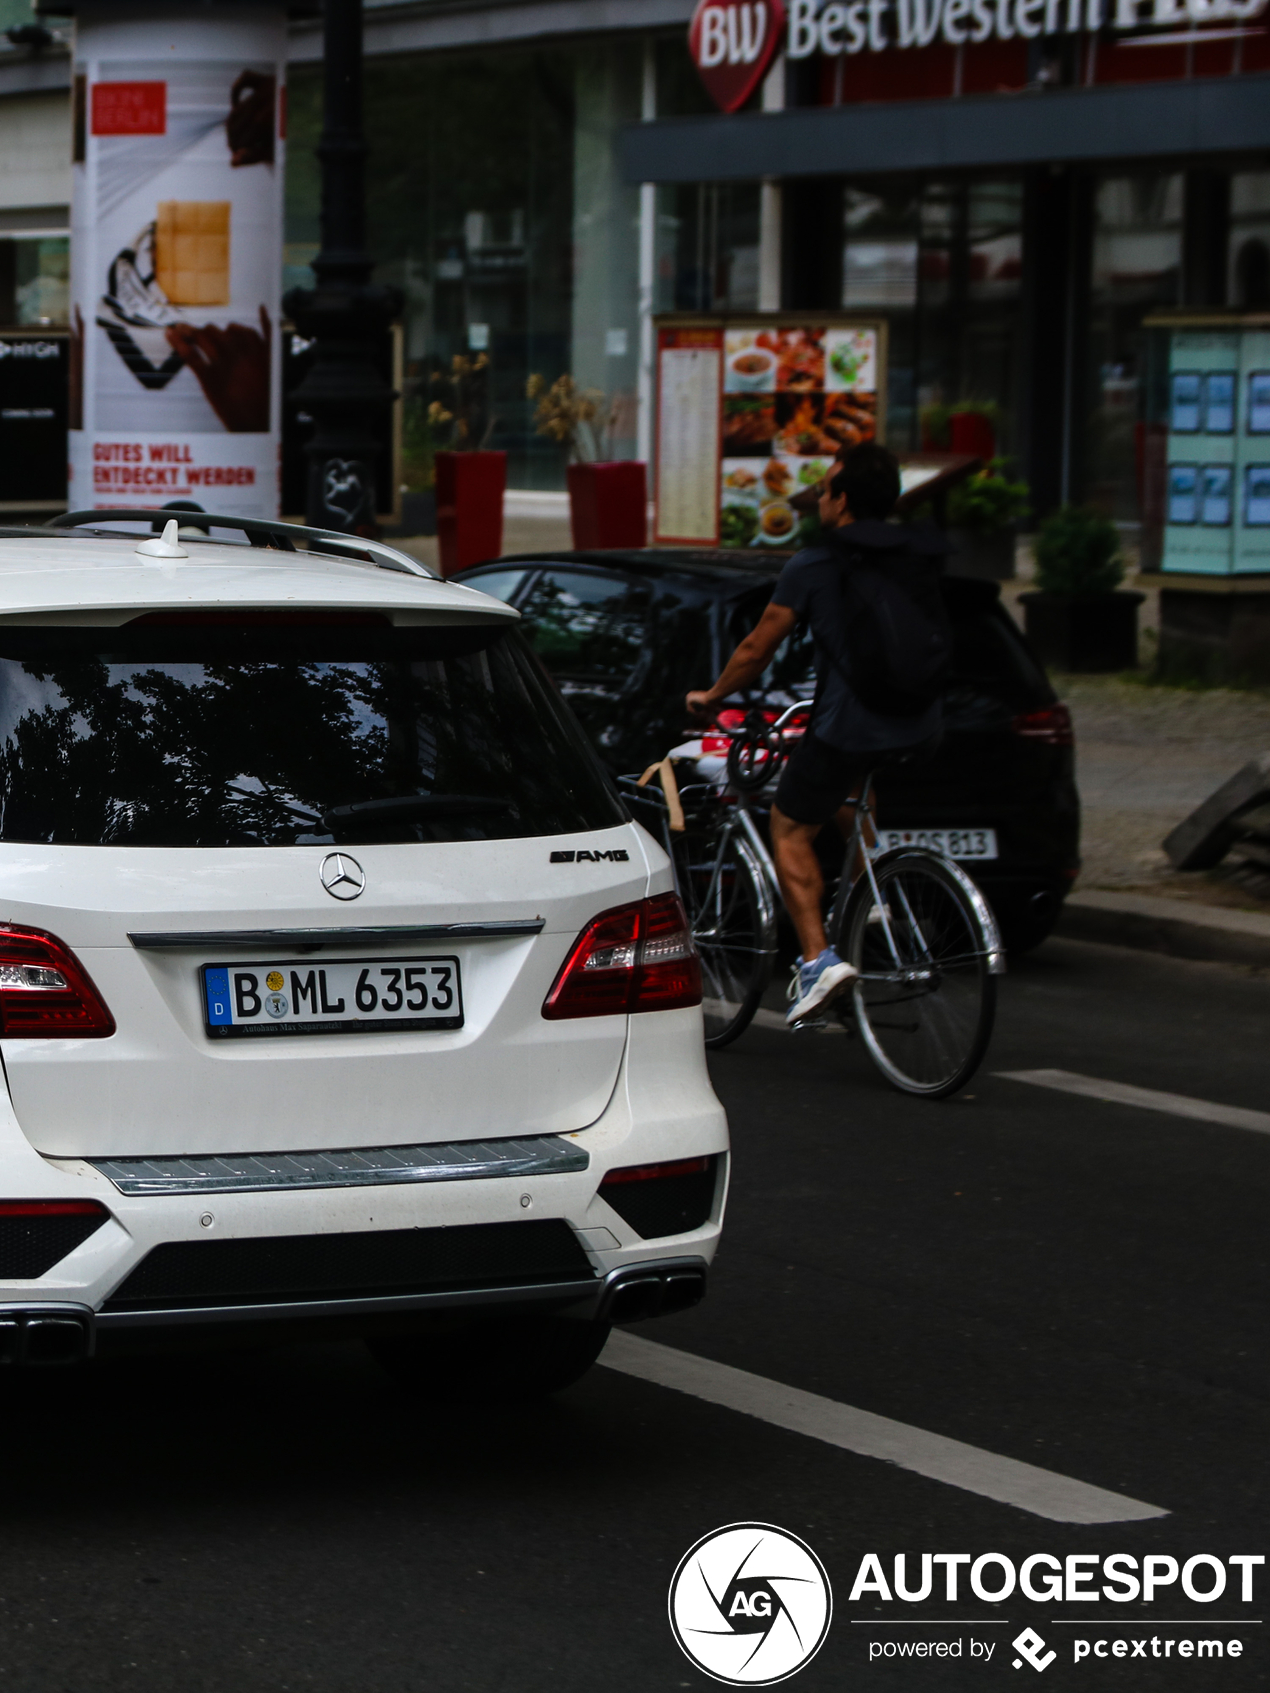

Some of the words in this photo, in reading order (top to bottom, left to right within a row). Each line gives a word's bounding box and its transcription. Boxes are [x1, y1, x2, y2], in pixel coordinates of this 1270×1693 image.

[698, 2, 768, 68] BW
[786, 0, 889, 60] Best
[93, 443, 143, 462] GUTES
[149, 444, 193, 463] WILL
[93, 466, 179, 485] ENTDECKT
[186, 467, 255, 486] WERDEN
[576, 849, 630, 863] AMG
[234, 973, 262, 1017] B
[290, 969, 345, 1014] ML
[355, 967, 453, 1012] 6353
[214, 1002, 224, 1016] D
[242, 1024, 278, 1034] Autohaus
